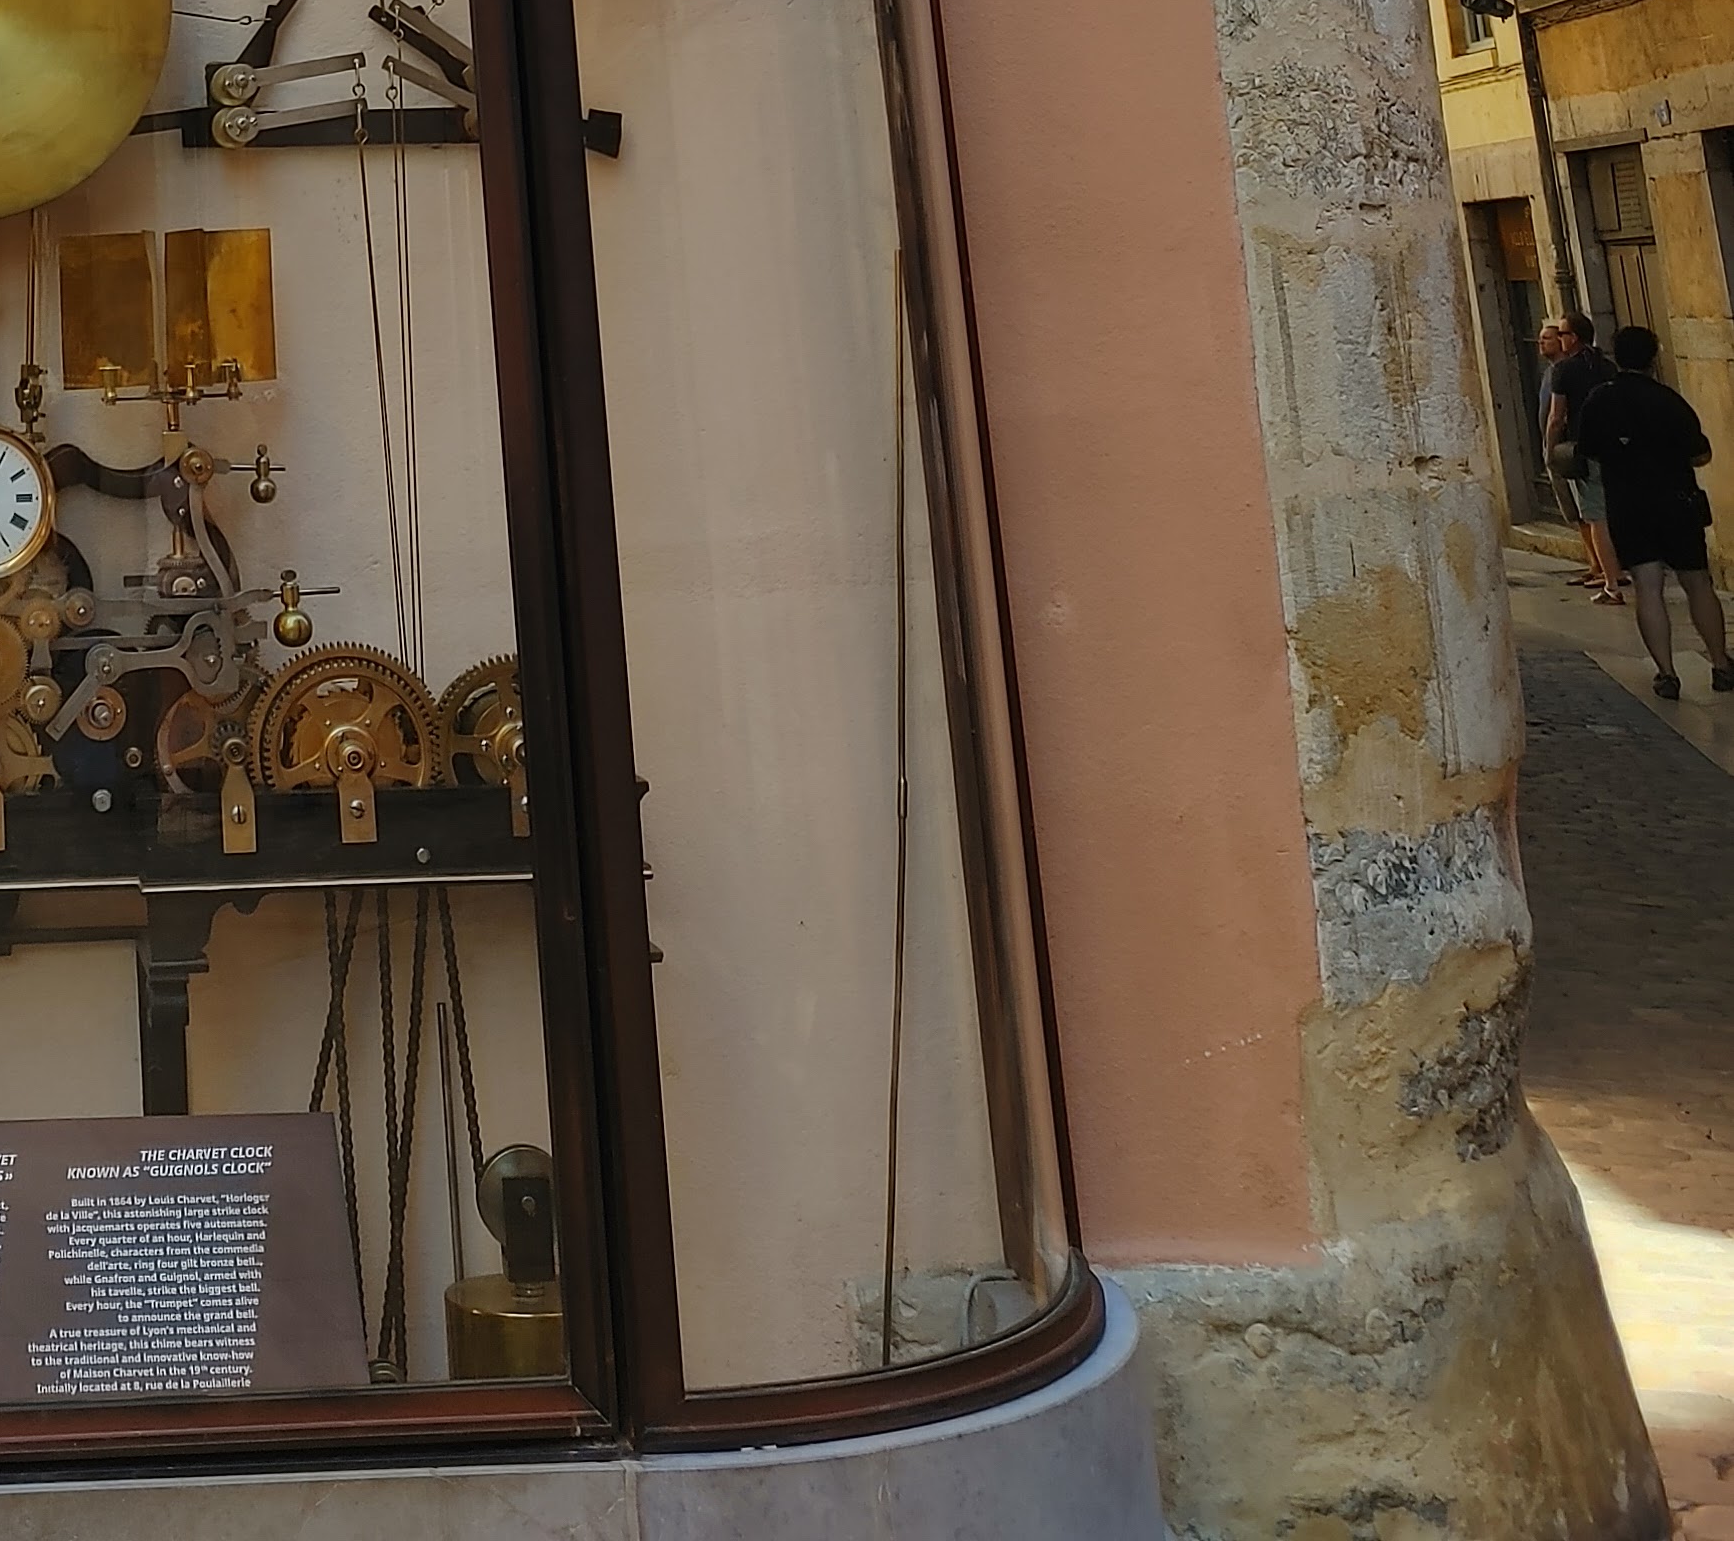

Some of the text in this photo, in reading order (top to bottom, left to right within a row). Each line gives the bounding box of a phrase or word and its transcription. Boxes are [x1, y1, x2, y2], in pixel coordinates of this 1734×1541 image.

[138, 1147, 273, 1162] THE CHARVET CLOCK
[67, 1167, 120, 1179] KNOWN
[122, 1166, 140, 1178] AS
[72, 1198, 94, 1208] Built
[97, 1197, 106, 1207] in
[134, 1196, 146, 1208] by
[149, 1195, 174, 1205] Louis
[46, 1211, 58, 1221] de
[61, 1211, 69, 1221] la
[103, 1210, 121, 1219] this
[124, 1208, 181, 1221] astonishing
[184, 1207, 209, 1219] large
[212, 1206, 240, 1216] strike
[243, 1205, 268, 1215] clock
[47, 1224, 69, 1234] with
[137, 1221, 180, 1233] operates
[184, 1220, 201, 1230] five
[69, 1236, 96, 1248] Every
[99, 1234, 136, 1247] quarter
[140, 1234, 149, 1244] of
[152, 1235, 164, 1243] an
[196, 1231, 244, 1244] Harlequin
[247, 1231, 265, 1240] and
[111, 1247, 164, 1257] characters
[166, 1246, 190, 1256] from
[194, 1245, 209, 1255] the
[213, 1244, 264, 1254] commedia
[134, 1260, 154, 1272] ring
[157, 1259, 178, 1269] four
[181, 1259, 198, 1271] gilt
[200, 1258, 234, 1268] bronze
[64, 1275, 92, 1285] while
[94, 1274, 135, 1284] Gnafron
[138, 1273, 156, 1283] and
[204, 1271, 236, 1281] armed
[239, 1270, 261, 1280] with
[91, 1288, 106, 1297] his
[148, 1285, 176, 1296] strike
[179, 1285, 196, 1295] the
[198, 1284, 236, 1296] biggest
[66, 1301, 94, 1313] Every
[125, 1299, 142, 1309] the
[200, 1298, 232, 1307] comes
[235, 1296, 258, 1306] alive
[118, 1313, 128, 1323] to
[132, 1313, 181, 1322] announce
[184, 1311, 200, 1321] the
[204, 1310, 233, 1322] grand
[60, 1328, 81, 1338] true
[84, 1327, 127, 1337] treasure
[130, 1326, 140, 1336] of
[177, 1323, 234, 1334] mechanical
[237, 1323, 256, 1333] and
[28, 1342, 77, 1353] theatrical
[130, 1340, 148, 1350] this
[152, 1339, 182, 1349] chime
[185, 1338, 213, 1348] bears
[215, 1337, 255, 1347] witness
